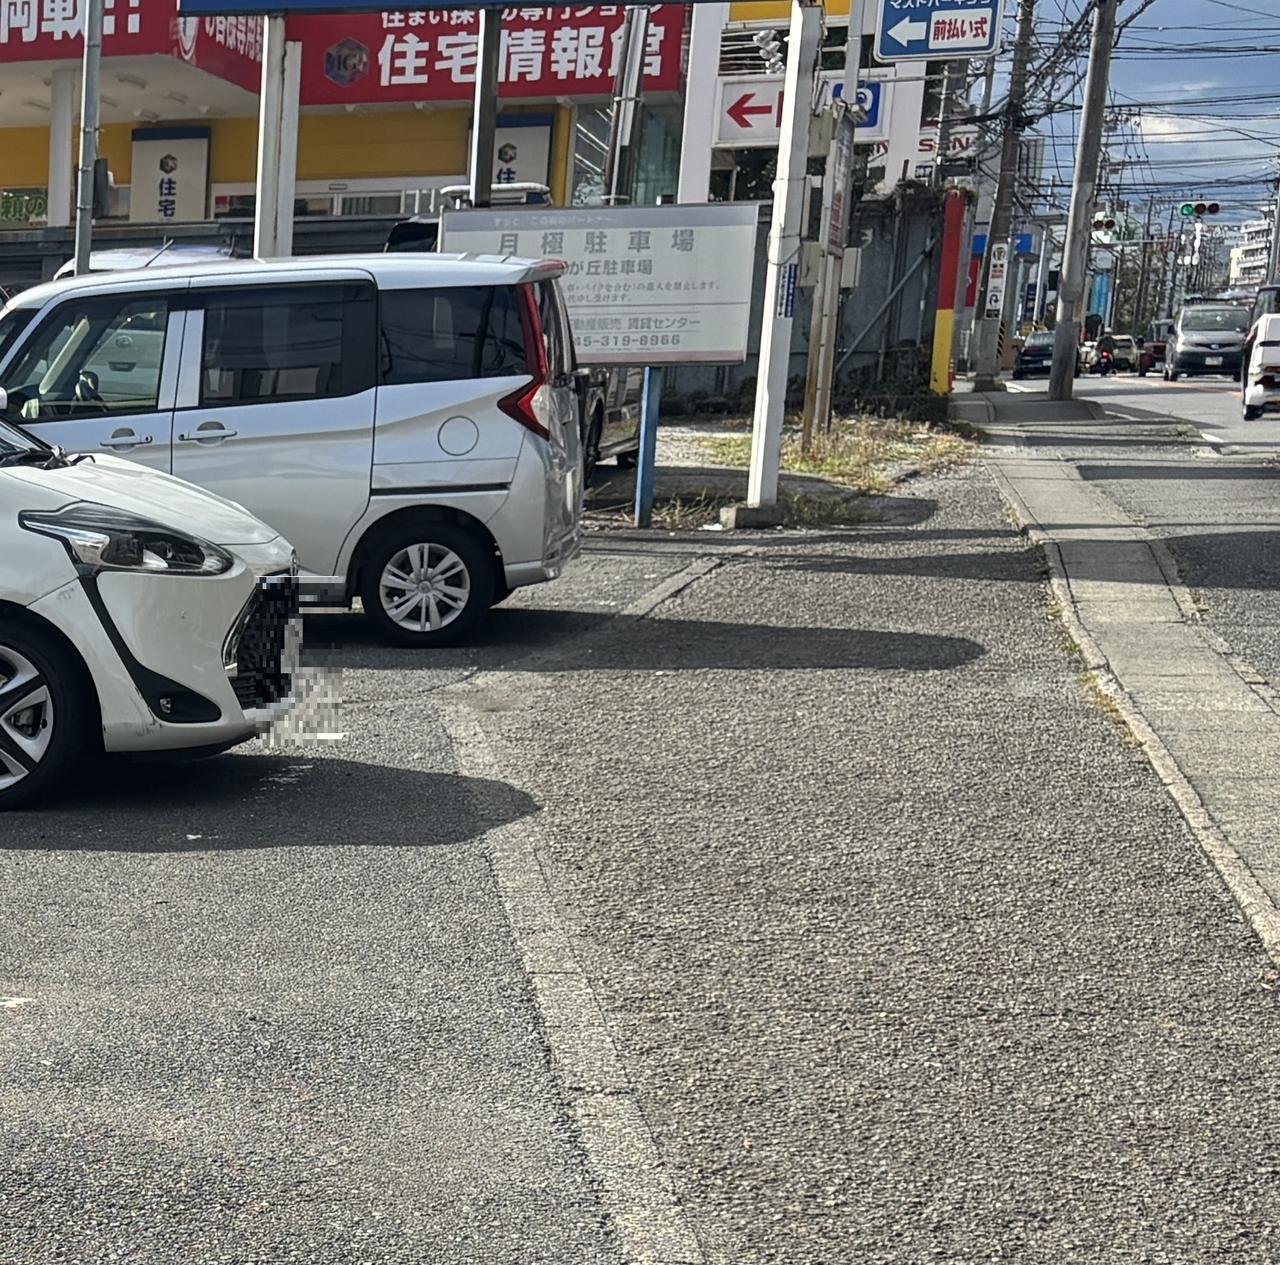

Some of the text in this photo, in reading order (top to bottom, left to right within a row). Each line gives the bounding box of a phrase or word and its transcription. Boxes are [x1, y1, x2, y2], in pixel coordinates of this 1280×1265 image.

[933, 17, 988, 41] 前払い式
[498, 229, 695, 256] 月極駐車場
